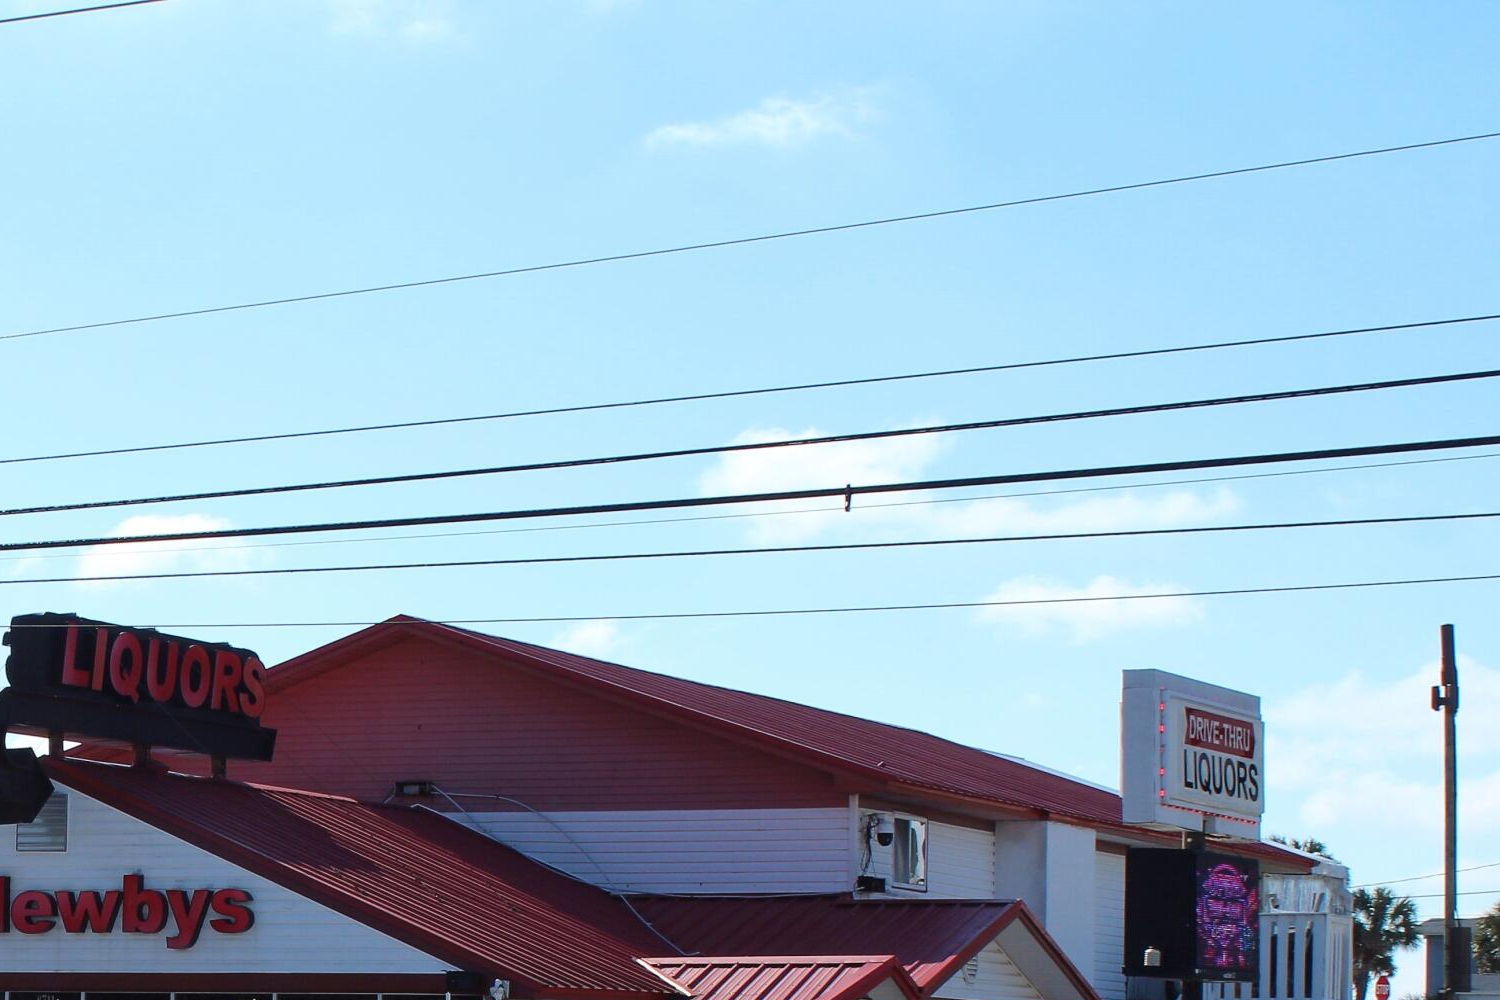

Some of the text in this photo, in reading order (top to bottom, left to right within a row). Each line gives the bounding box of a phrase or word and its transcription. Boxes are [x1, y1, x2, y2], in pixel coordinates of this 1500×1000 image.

[61, 620, 267, 718] LIQUORS
[1189, 714, 1250, 752] DRIVE-THRU
[1184, 749, 1259, 802] LIQUORS
